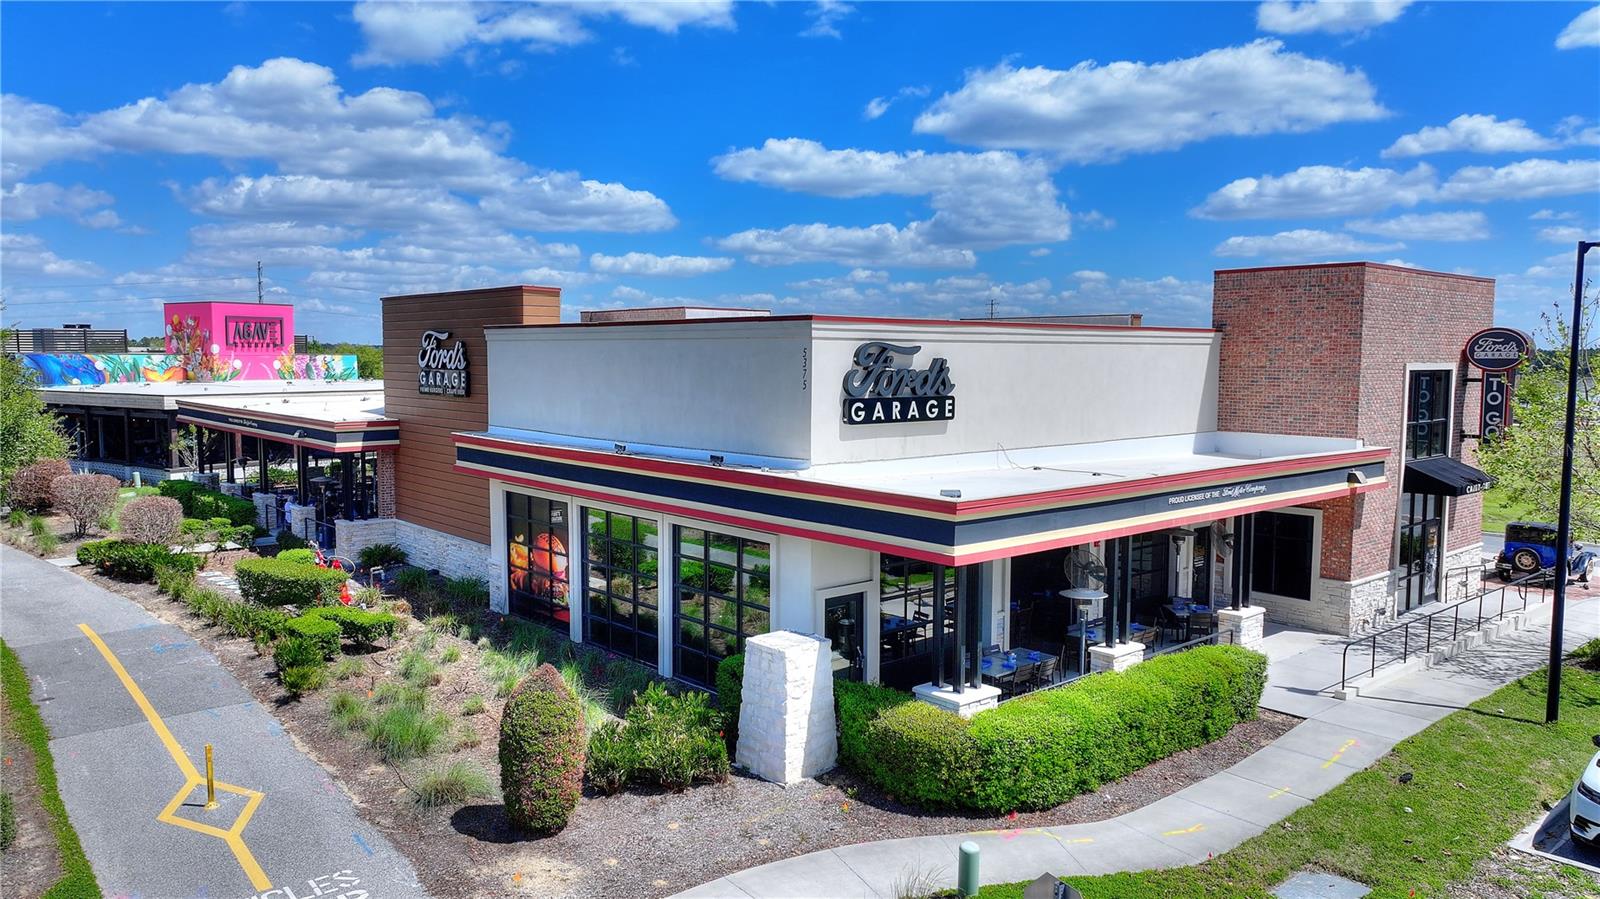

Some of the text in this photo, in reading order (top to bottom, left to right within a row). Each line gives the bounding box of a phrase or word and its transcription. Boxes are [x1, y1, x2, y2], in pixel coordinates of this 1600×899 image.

[233, 321, 278, 340] AGAVE
[418, 330, 467, 370] Ford's
[1474, 337, 1519, 352] Ford's
[420, 371, 466, 387] GARAGE
[843, 341, 955, 398] Ford's
[1486, 377, 1502, 406] TO
[851, 400, 953, 421] GARAGE
[1169, 496, 1185, 504] PROUD
